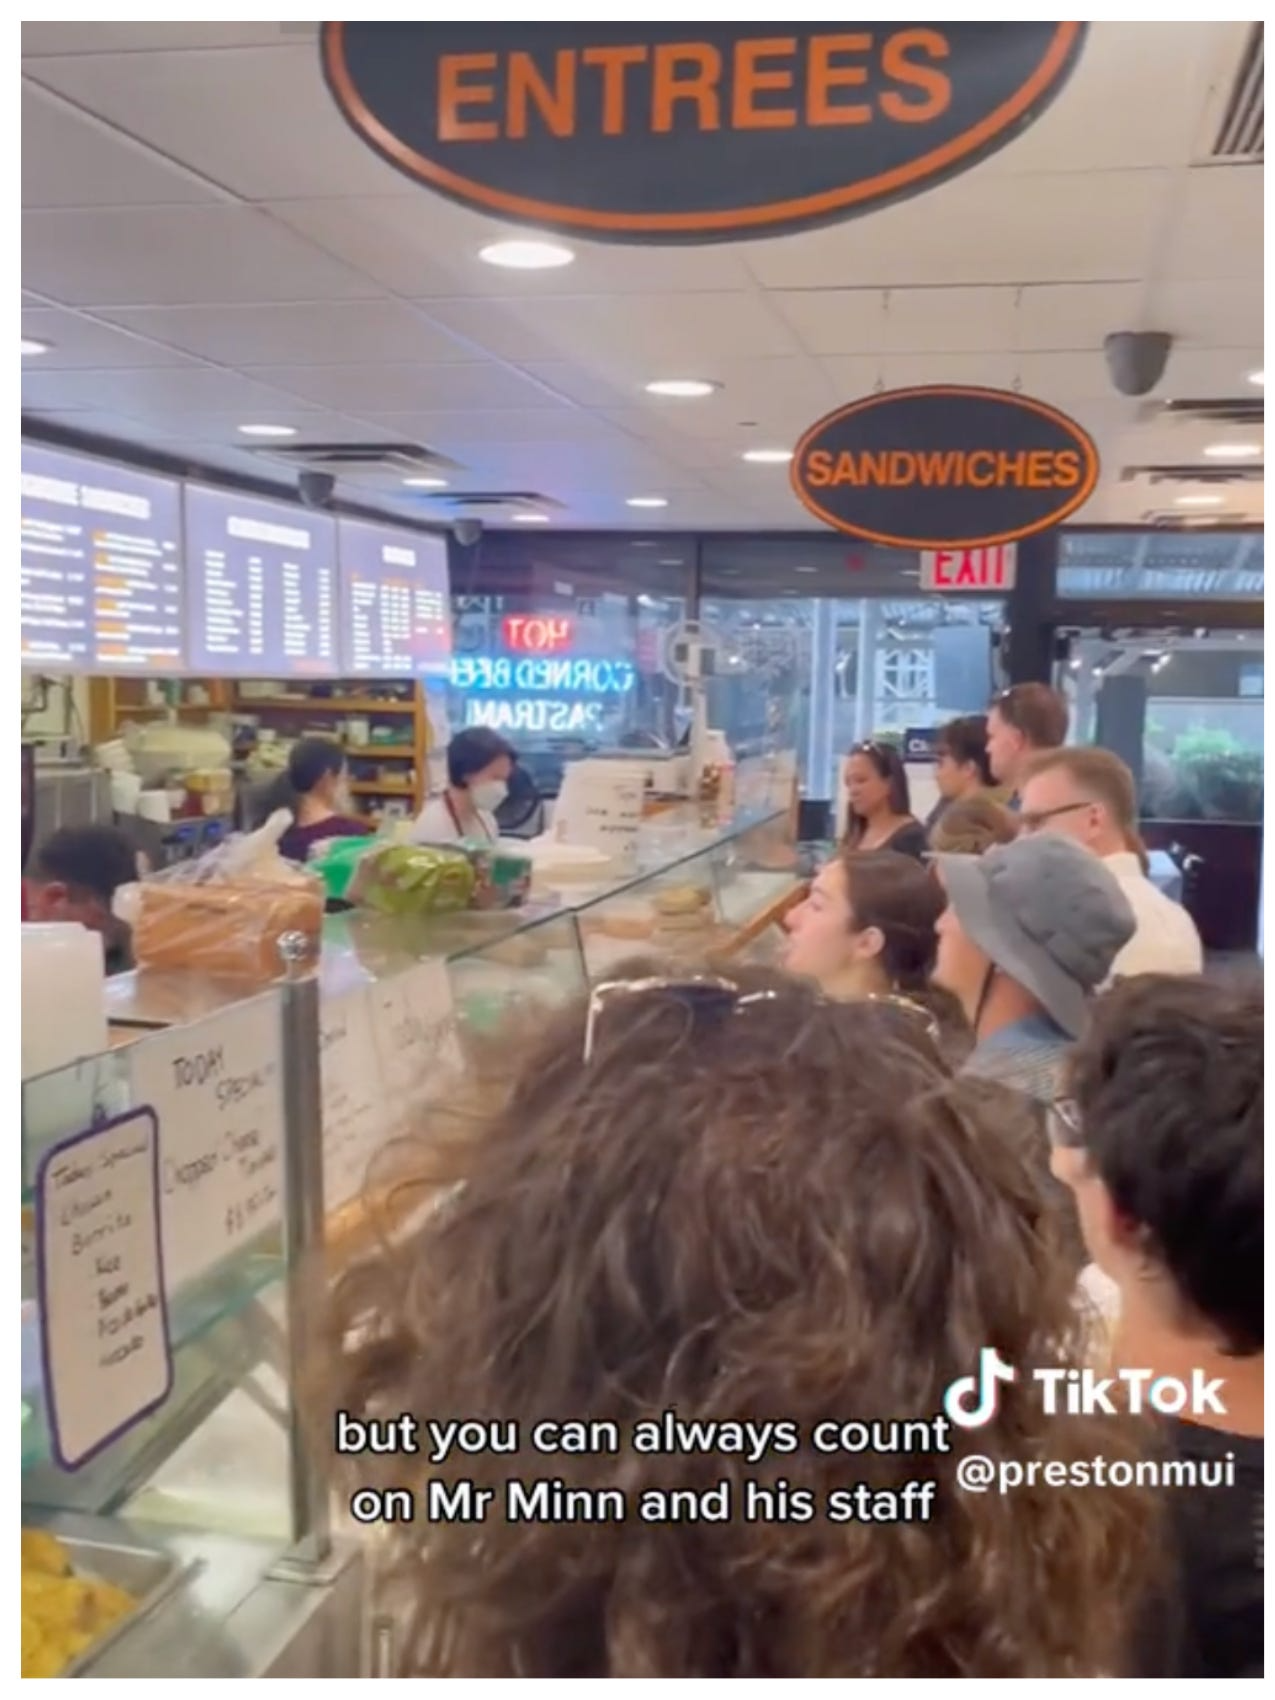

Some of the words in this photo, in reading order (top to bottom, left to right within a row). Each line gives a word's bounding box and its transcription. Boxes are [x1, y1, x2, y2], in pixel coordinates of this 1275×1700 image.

[437, 28, 952, 141] ENTREES
[806, 449, 1081, 488] SANDWICHES
[933, 543, 1004, 586] EXIT
